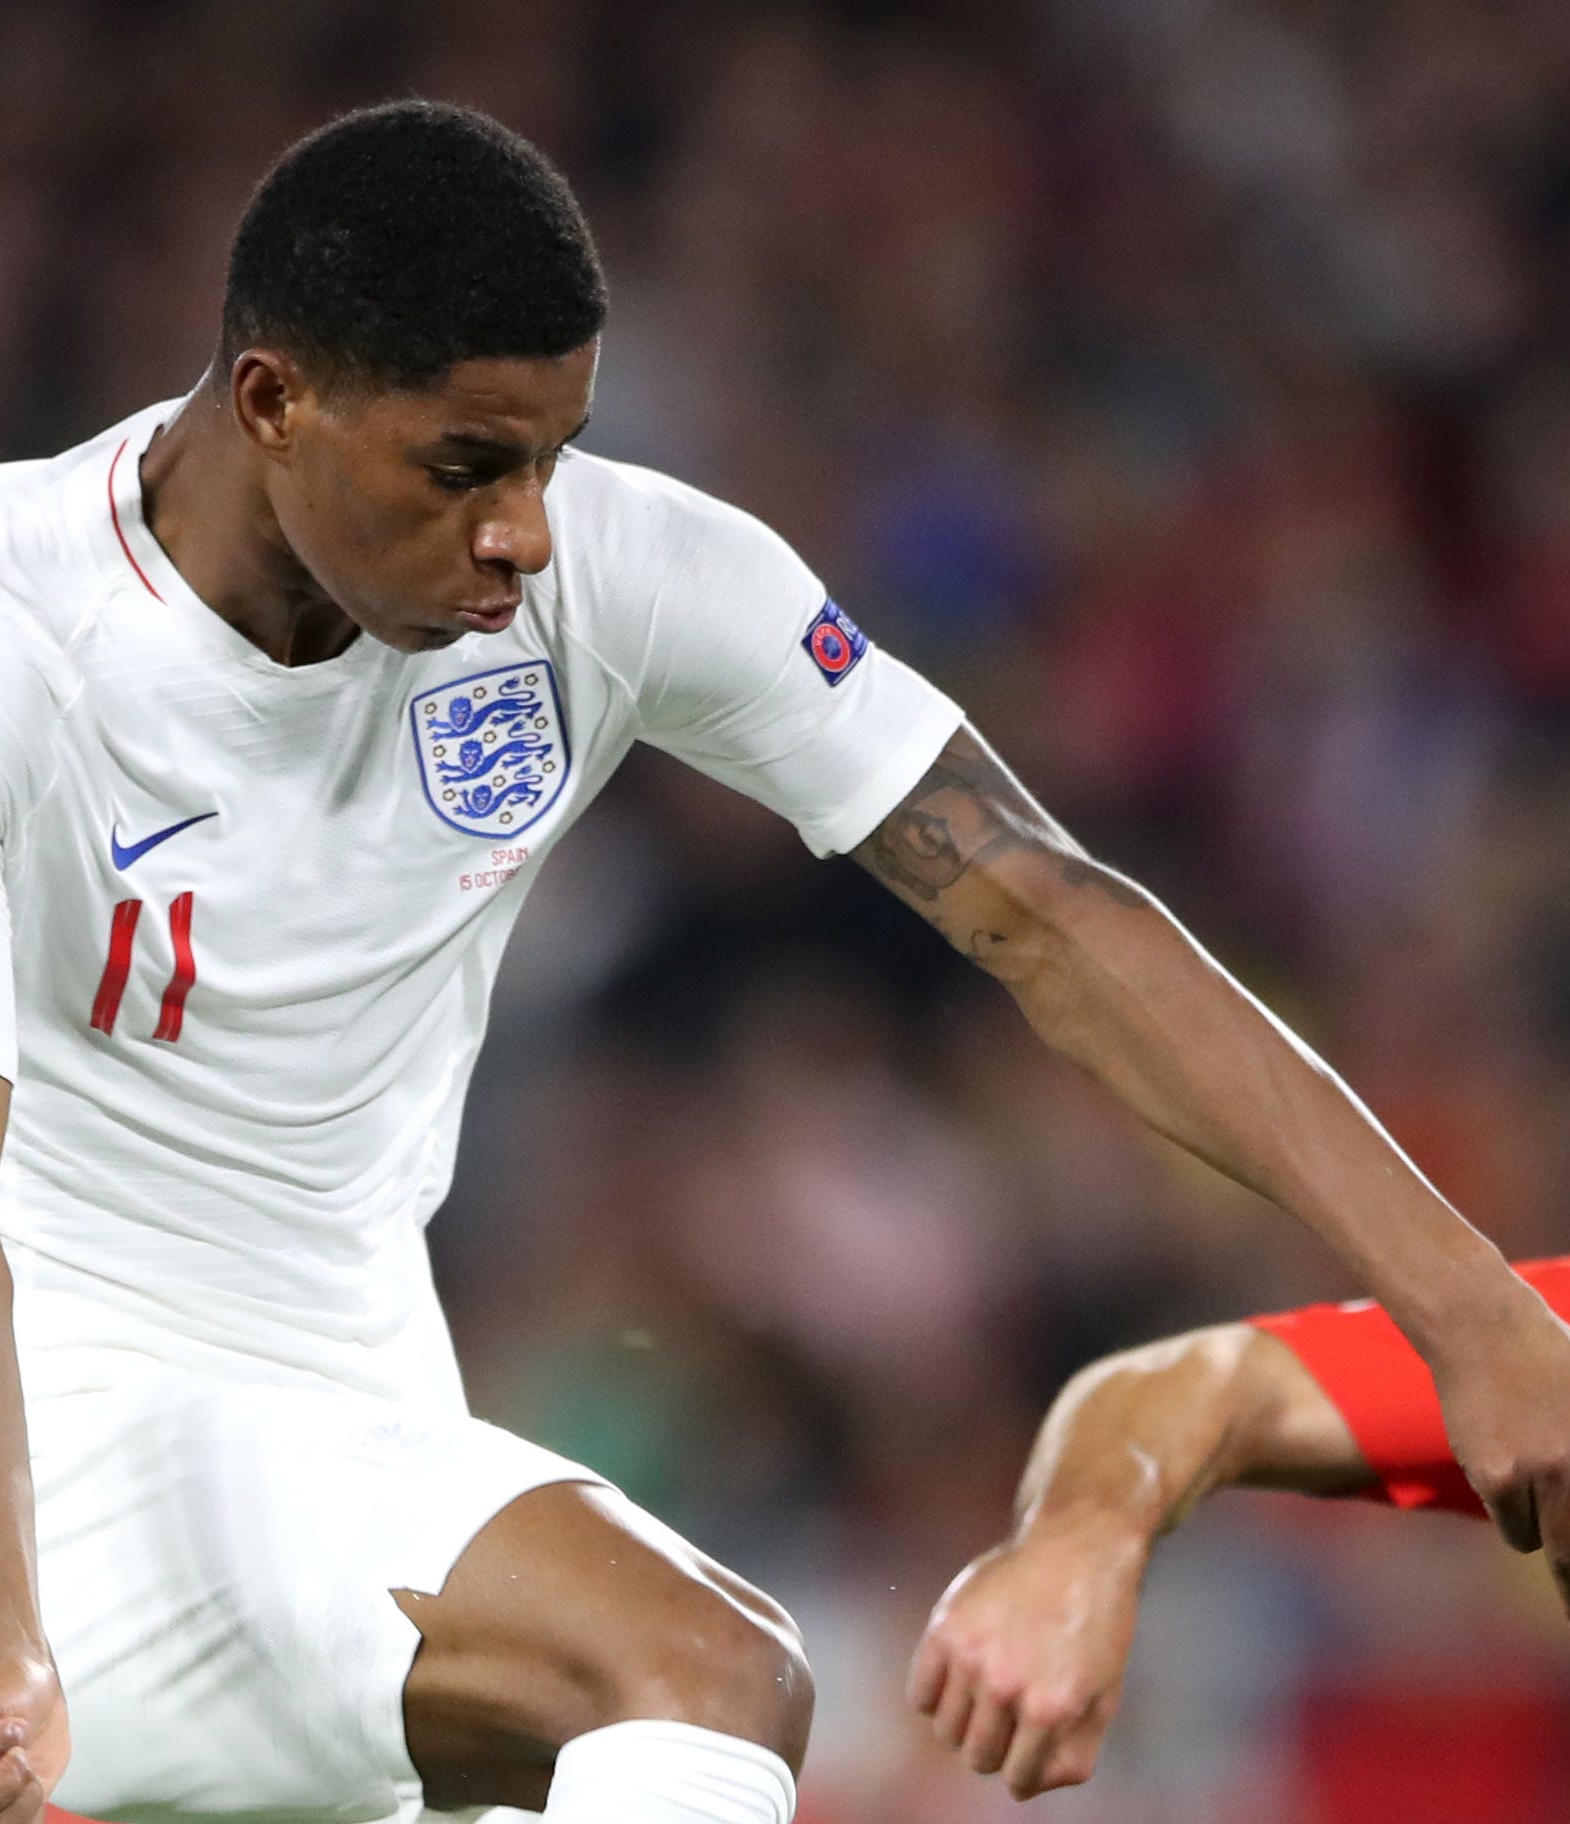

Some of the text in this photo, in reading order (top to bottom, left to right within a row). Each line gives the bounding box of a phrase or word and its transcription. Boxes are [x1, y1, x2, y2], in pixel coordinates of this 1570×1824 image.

[491, 847, 529, 866] SPAIN
[459, 873, 473, 891] 15
[89, 891, 196, 1043] 11
